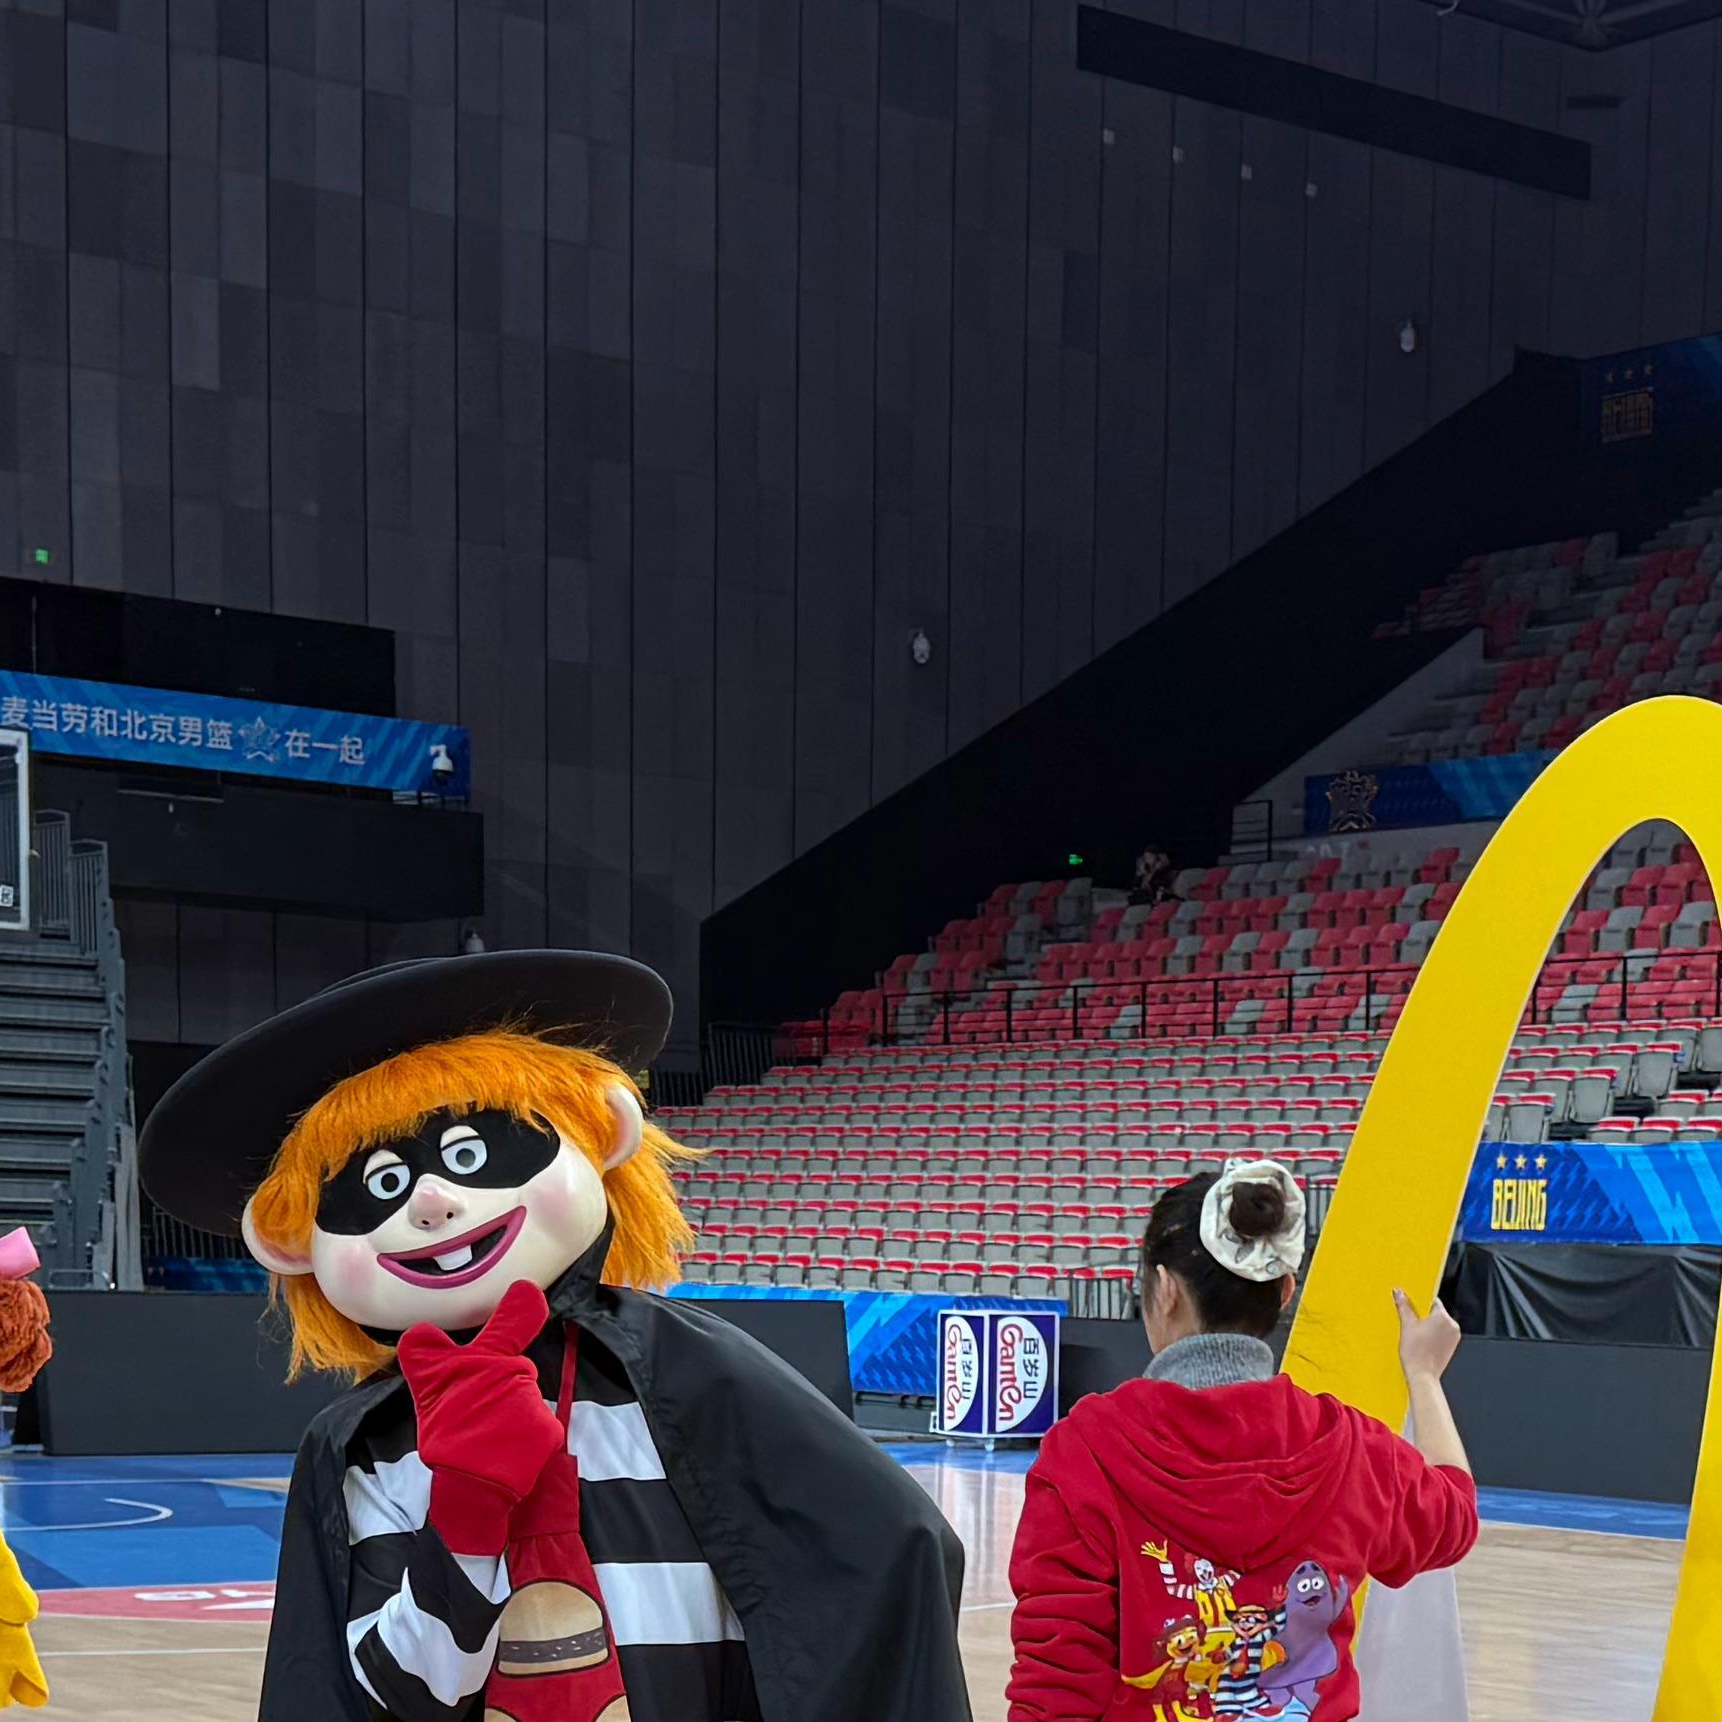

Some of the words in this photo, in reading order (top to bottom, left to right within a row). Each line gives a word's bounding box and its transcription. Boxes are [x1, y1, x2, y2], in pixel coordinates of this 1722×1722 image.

[0, 696, 234, 752] 麦当劳和北京男篮
[284, 727, 367, 766] 在一起
[1490, 1178, 1547, 1231] BEIJING
[1023, 1337, 1039, 1399] 百岁山
